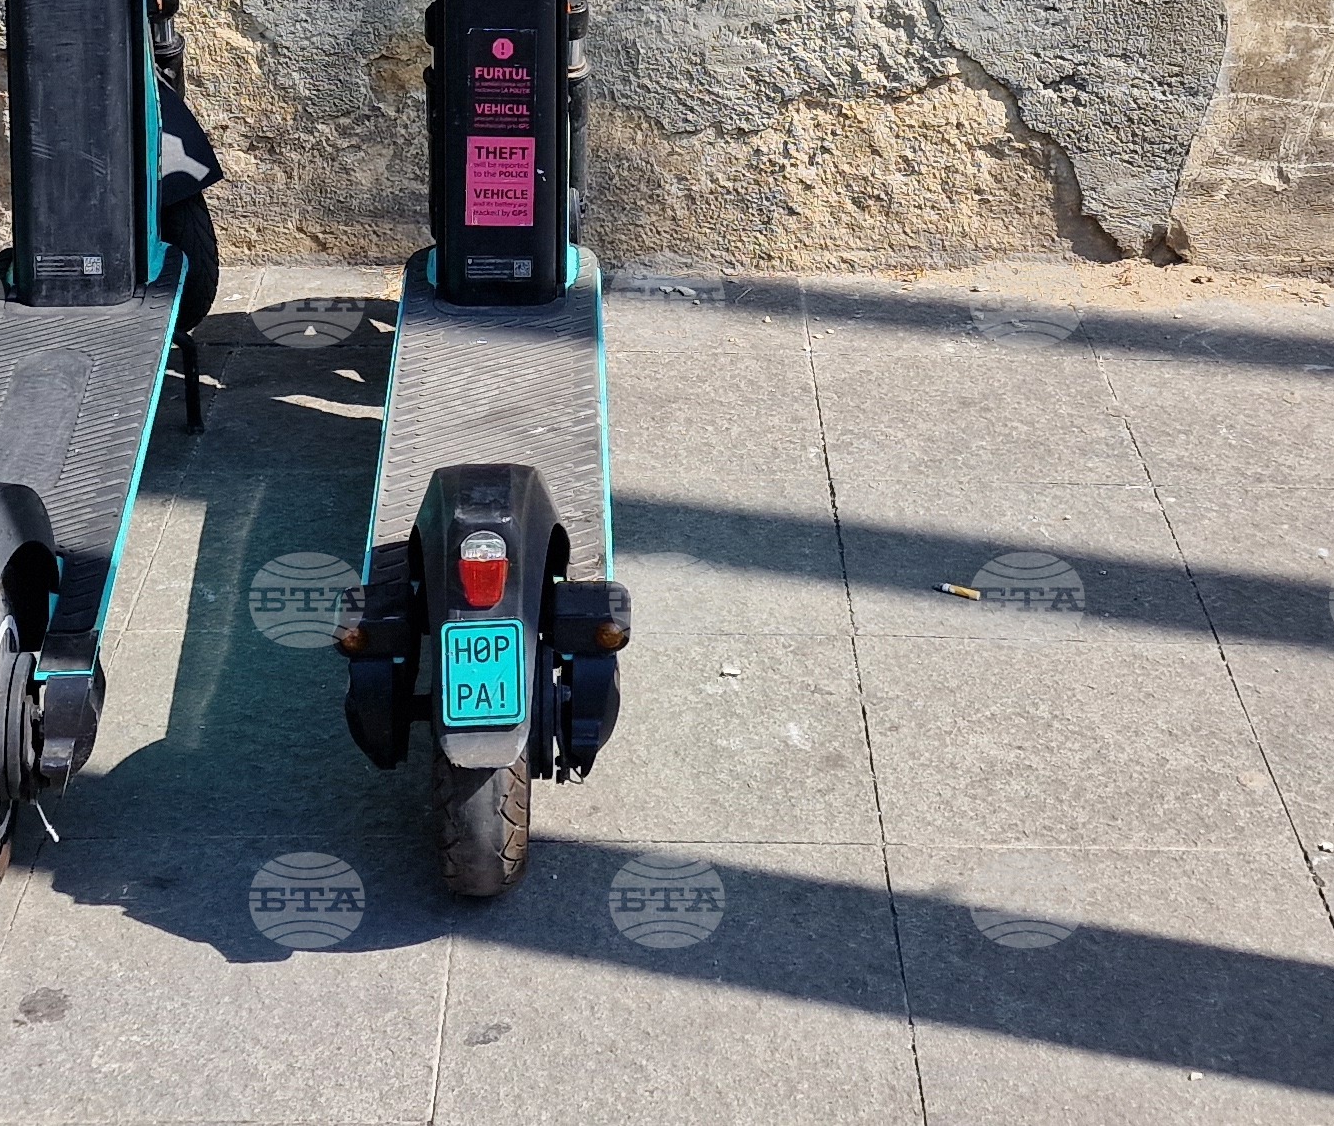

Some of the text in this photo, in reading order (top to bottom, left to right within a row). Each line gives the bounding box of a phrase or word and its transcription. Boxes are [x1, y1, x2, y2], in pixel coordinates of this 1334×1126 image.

[474, 66, 531, 80] FURTUL
[474, 103, 530, 115] VEHICUL
[474, 145, 530, 161] THEFT
[473, 170, 529, 179] to the POLICE
[473, 188, 528, 200] VEHICLE
[501, 209, 510, 218] by
[512, 209, 528, 217] GPS
[457, 681, 507, 711] PA!
